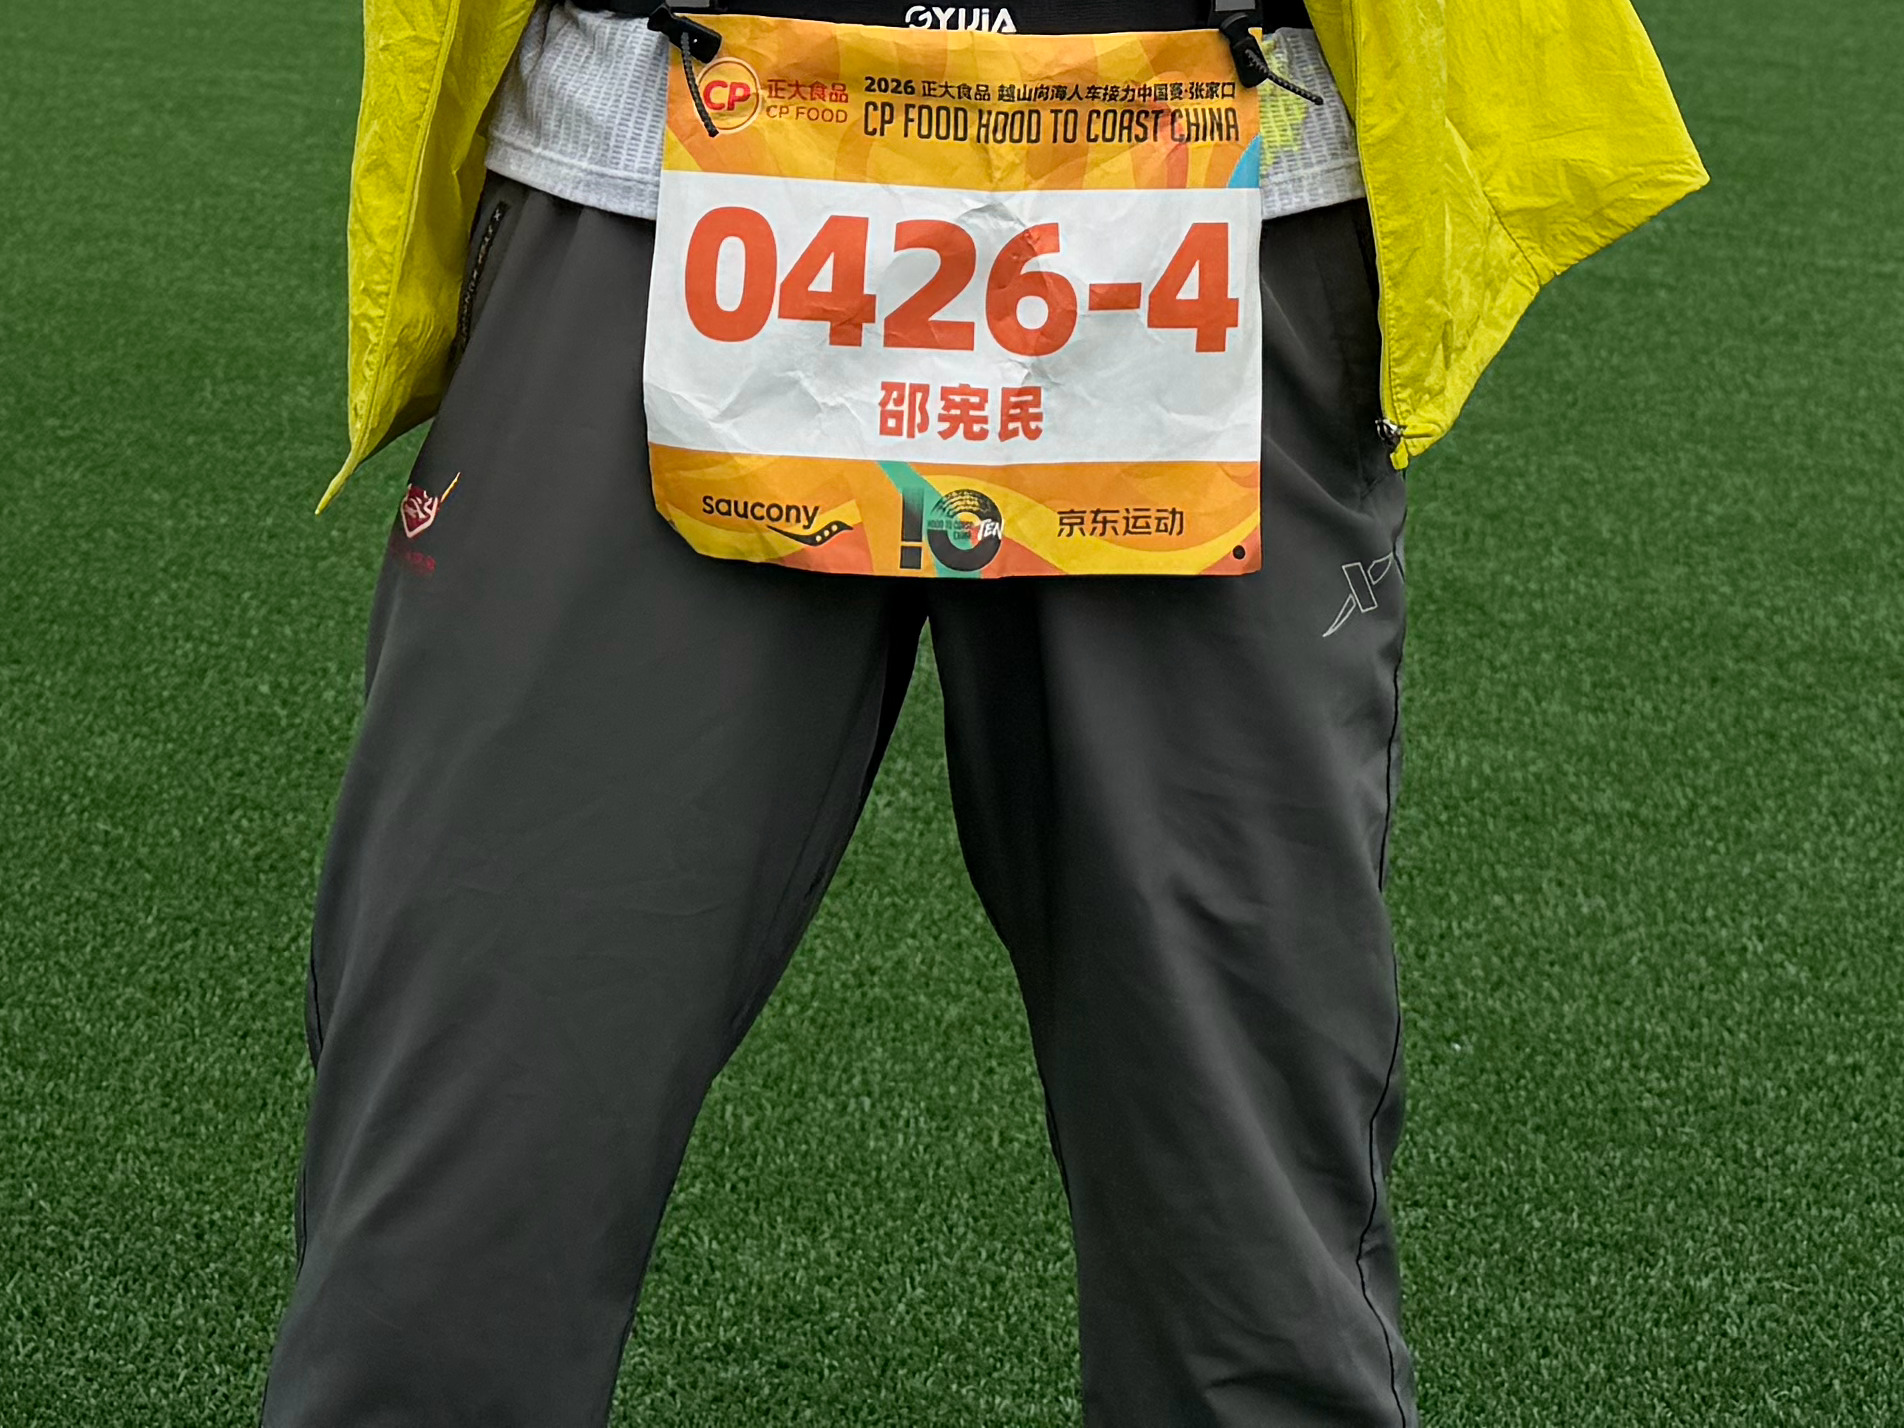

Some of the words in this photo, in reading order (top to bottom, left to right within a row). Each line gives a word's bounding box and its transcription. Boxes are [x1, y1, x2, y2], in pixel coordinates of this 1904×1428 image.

[702, 79, 751, 111] CP
[766, 79, 849, 103] 正大食品
[864, 76, 915, 95] 2026
[921, 80, 991, 101] 正大食品
[766, 104, 790, 120] CP
[795, 105, 849, 124] FOOD
[863, 101, 895, 137] CP
[903, 104, 968, 141] FOOD
[977, 108, 1041, 144] HOOD
[1049, 108, 1078, 144] TO
[1085, 108, 1164, 143] COAST
[1170, 106, 1240, 143] CHINA
[684, 206, 1240, 357] 0426-4
[879, 380, 1044, 443] 邵宪民
[702, 494, 820, 529] saucony
[1056, 507, 1184, 538] 京东运动
